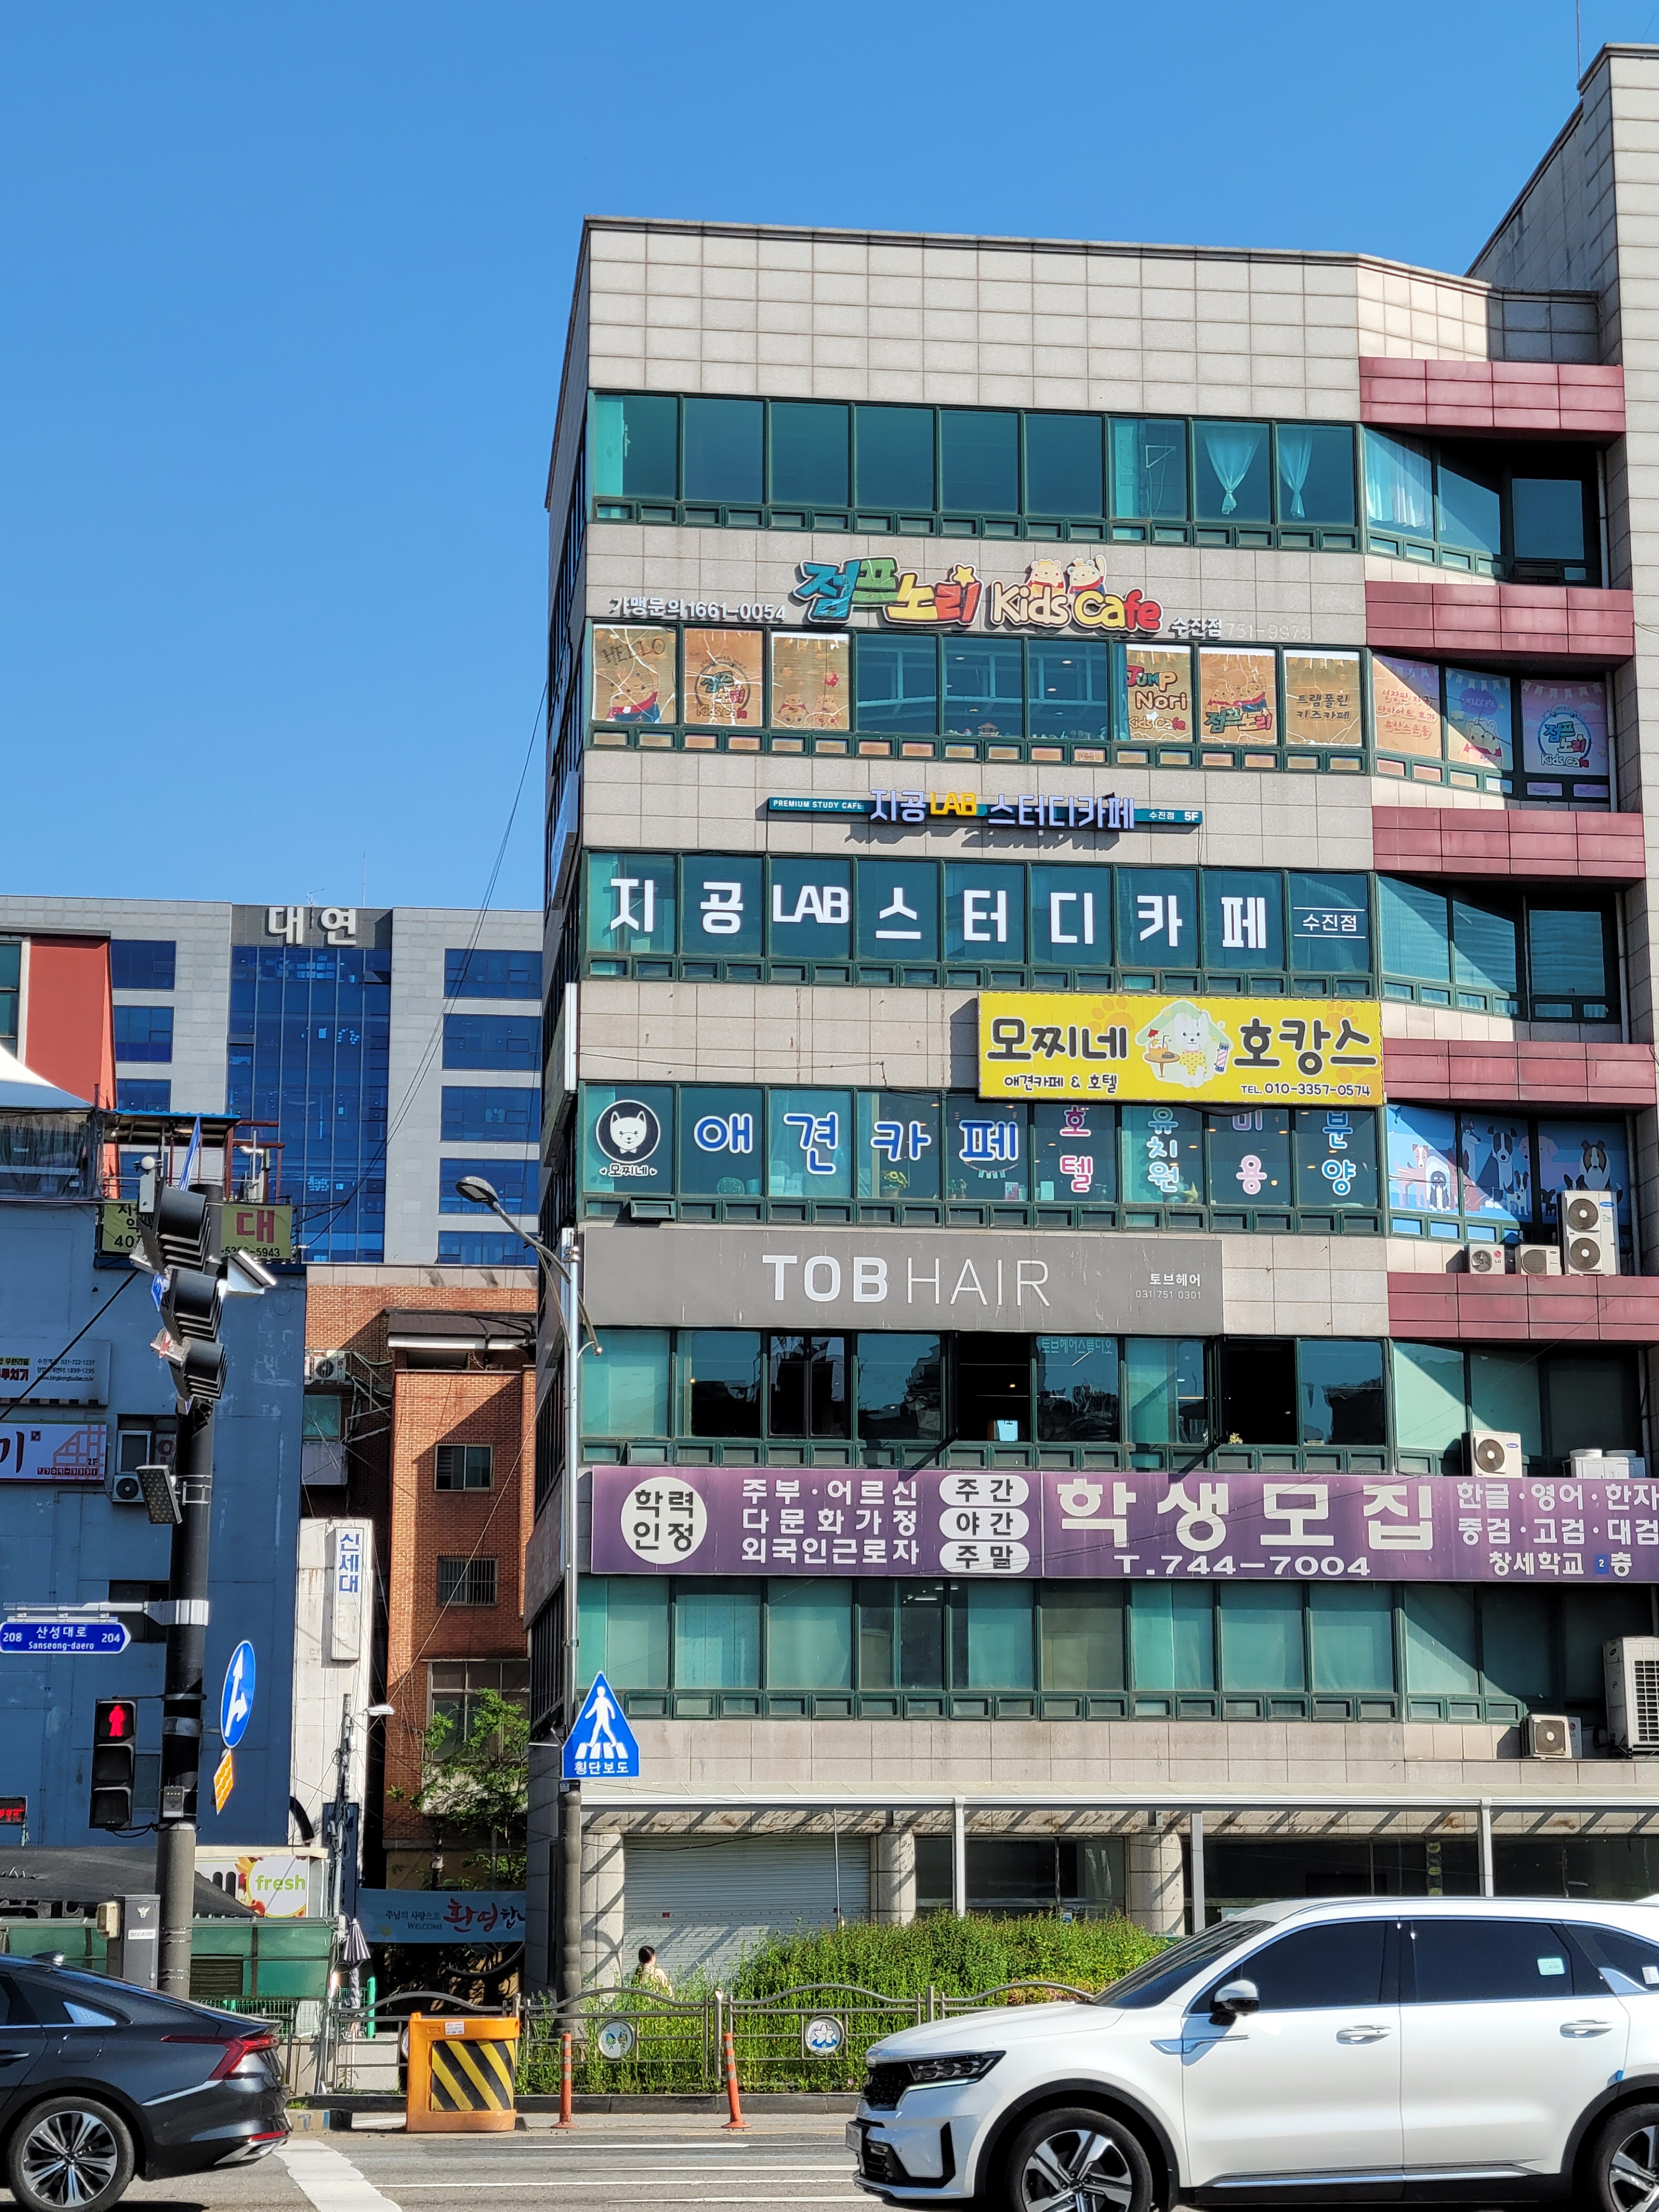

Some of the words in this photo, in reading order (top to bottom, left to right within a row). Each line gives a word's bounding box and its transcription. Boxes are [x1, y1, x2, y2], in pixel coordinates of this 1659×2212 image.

[794, 557, 983, 624] 점프노리
[991, 582, 1070, 627] Kids
[1073, 589, 1164, 632] Cafe
[1172, 617, 1222, 637] 수진점
[602, 637, 665, 665] HELLO
[1135, 690, 1188, 711] Nori
[1296, 693, 1349, 709] 트램폴린
[1381, 689, 1409, 702] 성장판
[1204, 708, 1273, 734] 점프노리
[1296, 709, 1350, 720] 키즈카페
[1378, 705, 1413, 718] 다이어트
[1418, 712, 1436, 721] 효과
[1153, 716, 1186, 731] Cafe
[1384, 720, 1431, 737] 유산소운동
[1543, 721, 1576, 743] 점프
[1557, 737, 1587, 753] 노리
[1541, 753, 1564, 765] Kids
[1565, 756, 1589, 768] Cafe
[773, 799, 809, 808] PREMIUM
[812, 800, 839, 809] STUDY
[842, 802, 862, 810] CAFE
[988, 793, 1135, 830] 스터디카페
[1149, 811, 1175, 820] 수진점
[1184, 811, 1199, 821] 5F
[268, 906, 357, 945] 대연
[1302, 913, 1357, 932] 수진점
[986, 1017, 1128, 1060] 모찌네
[1233, 1017, 1377, 1076] 호캉스
[1005, 1073, 1064, 1090] 애견카페
[1071, 1076, 1081, 1088] &
[1087, 1074, 1118, 1093] 호텔
[1240, 1084, 1262, 1094] TEL.
[1263, 1082, 1372, 1097] 010-3357-0574
[1146, 1107, 1180, 1194] 유치원
[608, 1164, 648, 1177] 모찌네
[761, 1254, 889, 1304] TOB
[906, 1257, 1051, 1307] HAIR
[1149, 1273, 1200, 1288] 토브헤어
[1135, 1290, 1153, 1299] 031
[1156, 1290, 1173, 1299] 751
[1178, 1291, 1201, 1300] 0301
[1041, 1338, 1113, 1355] 토브헤어스튜디오
[5, 1357, 29, 1366] 무한리필
[87, 1458, 98, 1466] 2F
[37, 1467, 98, 1476] T.709-3331
[955, 1479, 1013, 1504] 주간
[634, 1488, 695, 1519] 학력
[742, 1508, 918, 1537] 다문화가정
[1057, 1478, 1434, 1552] 학생모집
[955, 1511, 1014, 1537] 야간
[633, 1521, 694, 1551] 인정
[741, 1537, 919, 1566] 외국인근로자
[955, 1545, 1014, 1571] 주말
[338, 1533, 360, 1594] 신세대
[1489, 1551, 1584, 1577] 창세학교
[3, 1632, 22, 1643] 208
[36, 1625, 87, 1640] 산성대로
[101, 1633, 121, 1643] 204
[28, 1640, 95, 1651] Sanseong-daero
[574, 1760, 630, 1775] 횡단보도
[255, 1874, 306, 1891] fresh
[385, 1910, 408, 1920] 주님의
[410, 1911, 441, 1921] 사랑으로
[407, 1922, 443, 1931] WELCOME
